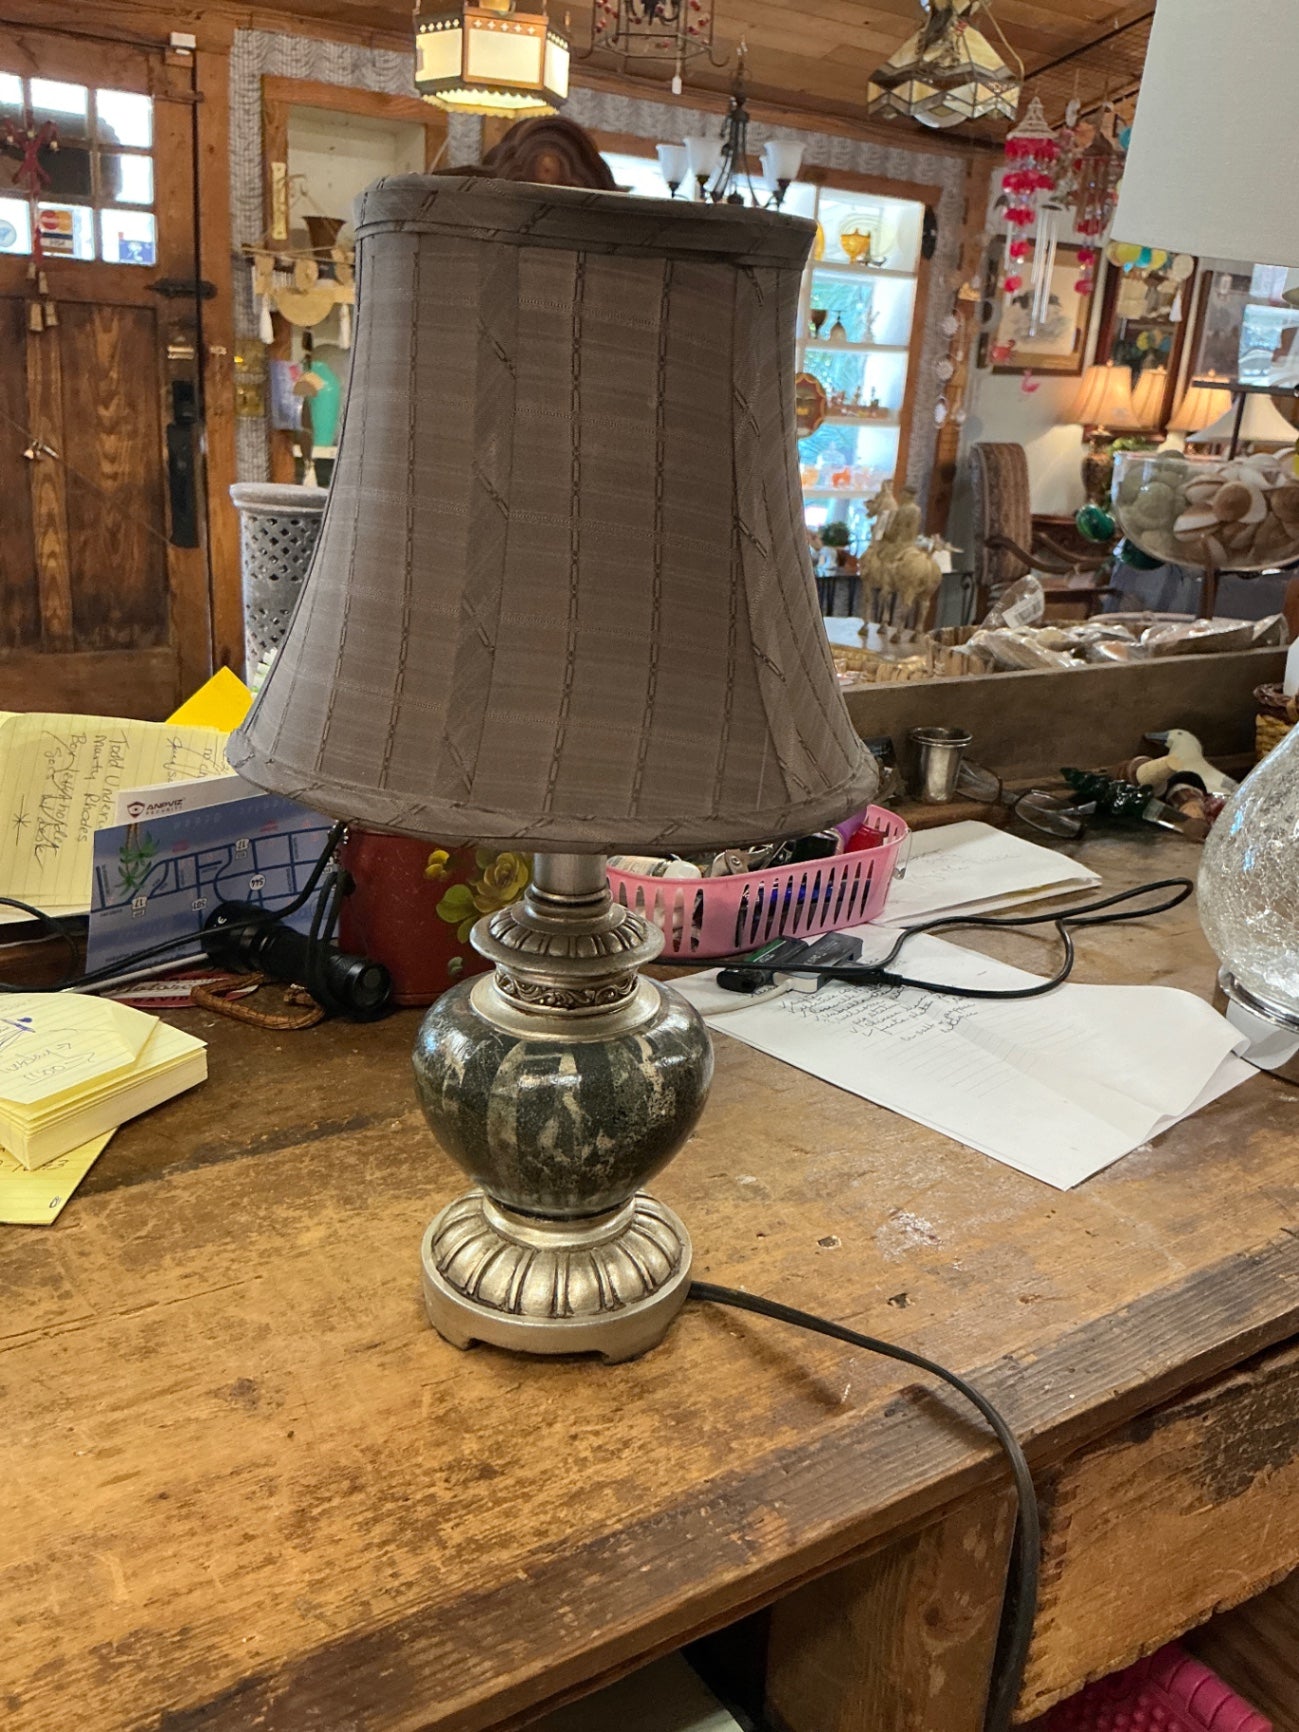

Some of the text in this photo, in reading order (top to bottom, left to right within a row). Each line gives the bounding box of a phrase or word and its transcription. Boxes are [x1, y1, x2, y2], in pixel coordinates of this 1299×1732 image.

[108, 730, 129, 770] Todd
[77, 793, 100, 842] Rhodes
[252, 877, 265, 887] 544
[134, 899, 144, 908] 17
[194, 901, 206, 909] 501
